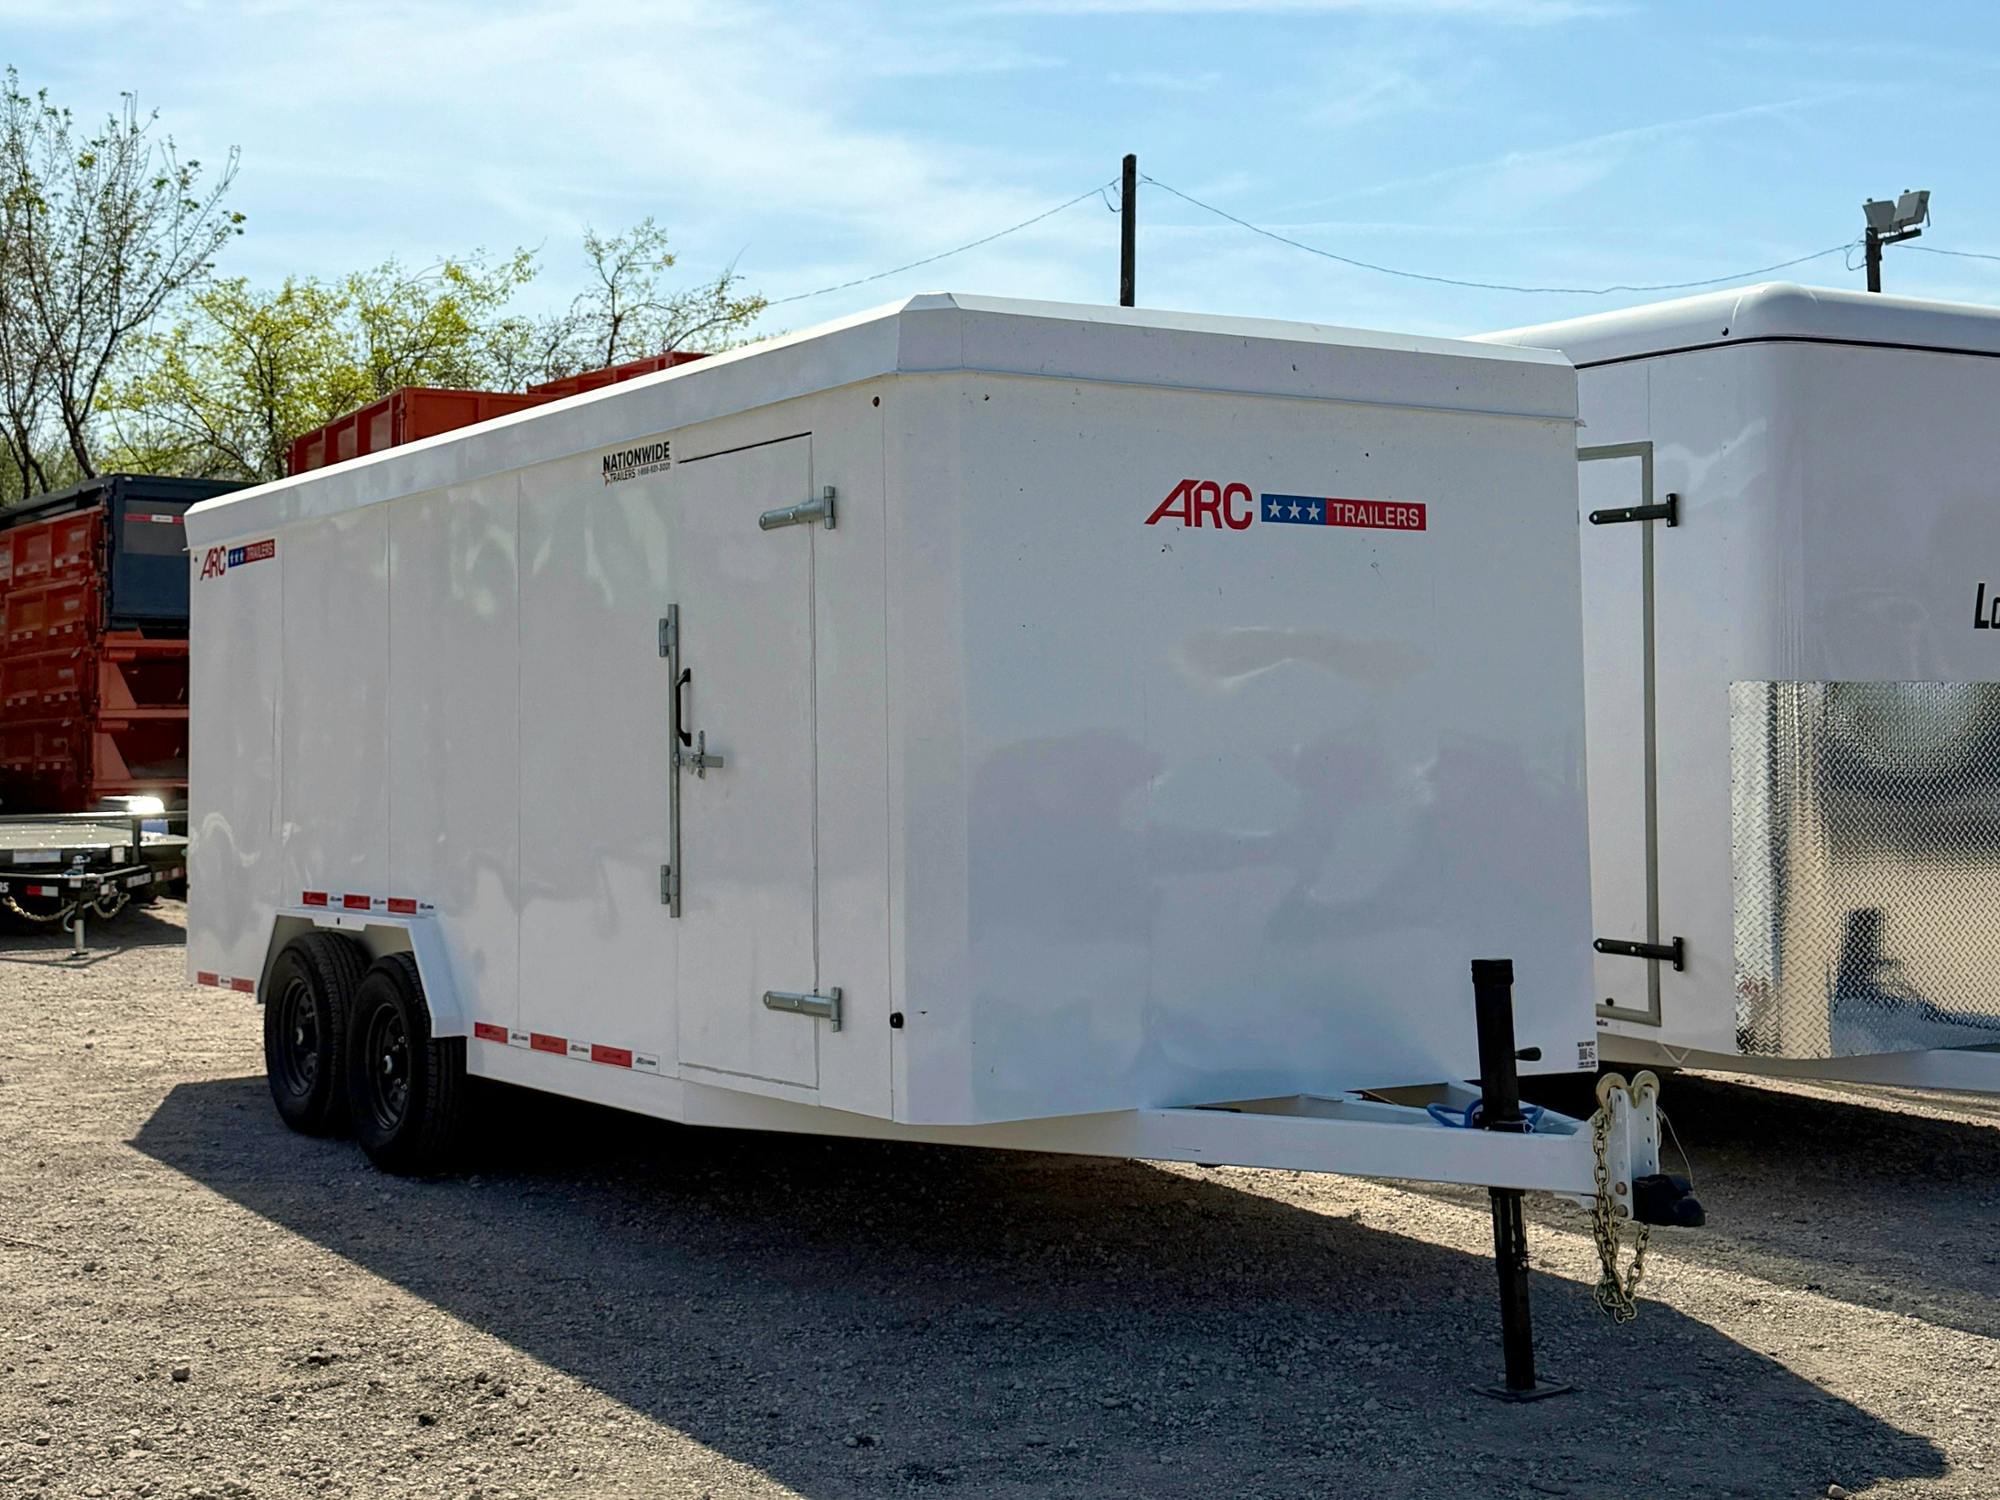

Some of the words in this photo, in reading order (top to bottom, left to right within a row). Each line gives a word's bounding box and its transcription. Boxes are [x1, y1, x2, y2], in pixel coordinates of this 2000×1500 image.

[603, 441, 670, 472] NATIONWIDE
[609, 468, 636, 483] TRAILERS
[1144, 479, 1253, 530] ARC
[1333, 503, 1419, 528] TRAILERS
[200, 545, 226, 581] ARC
